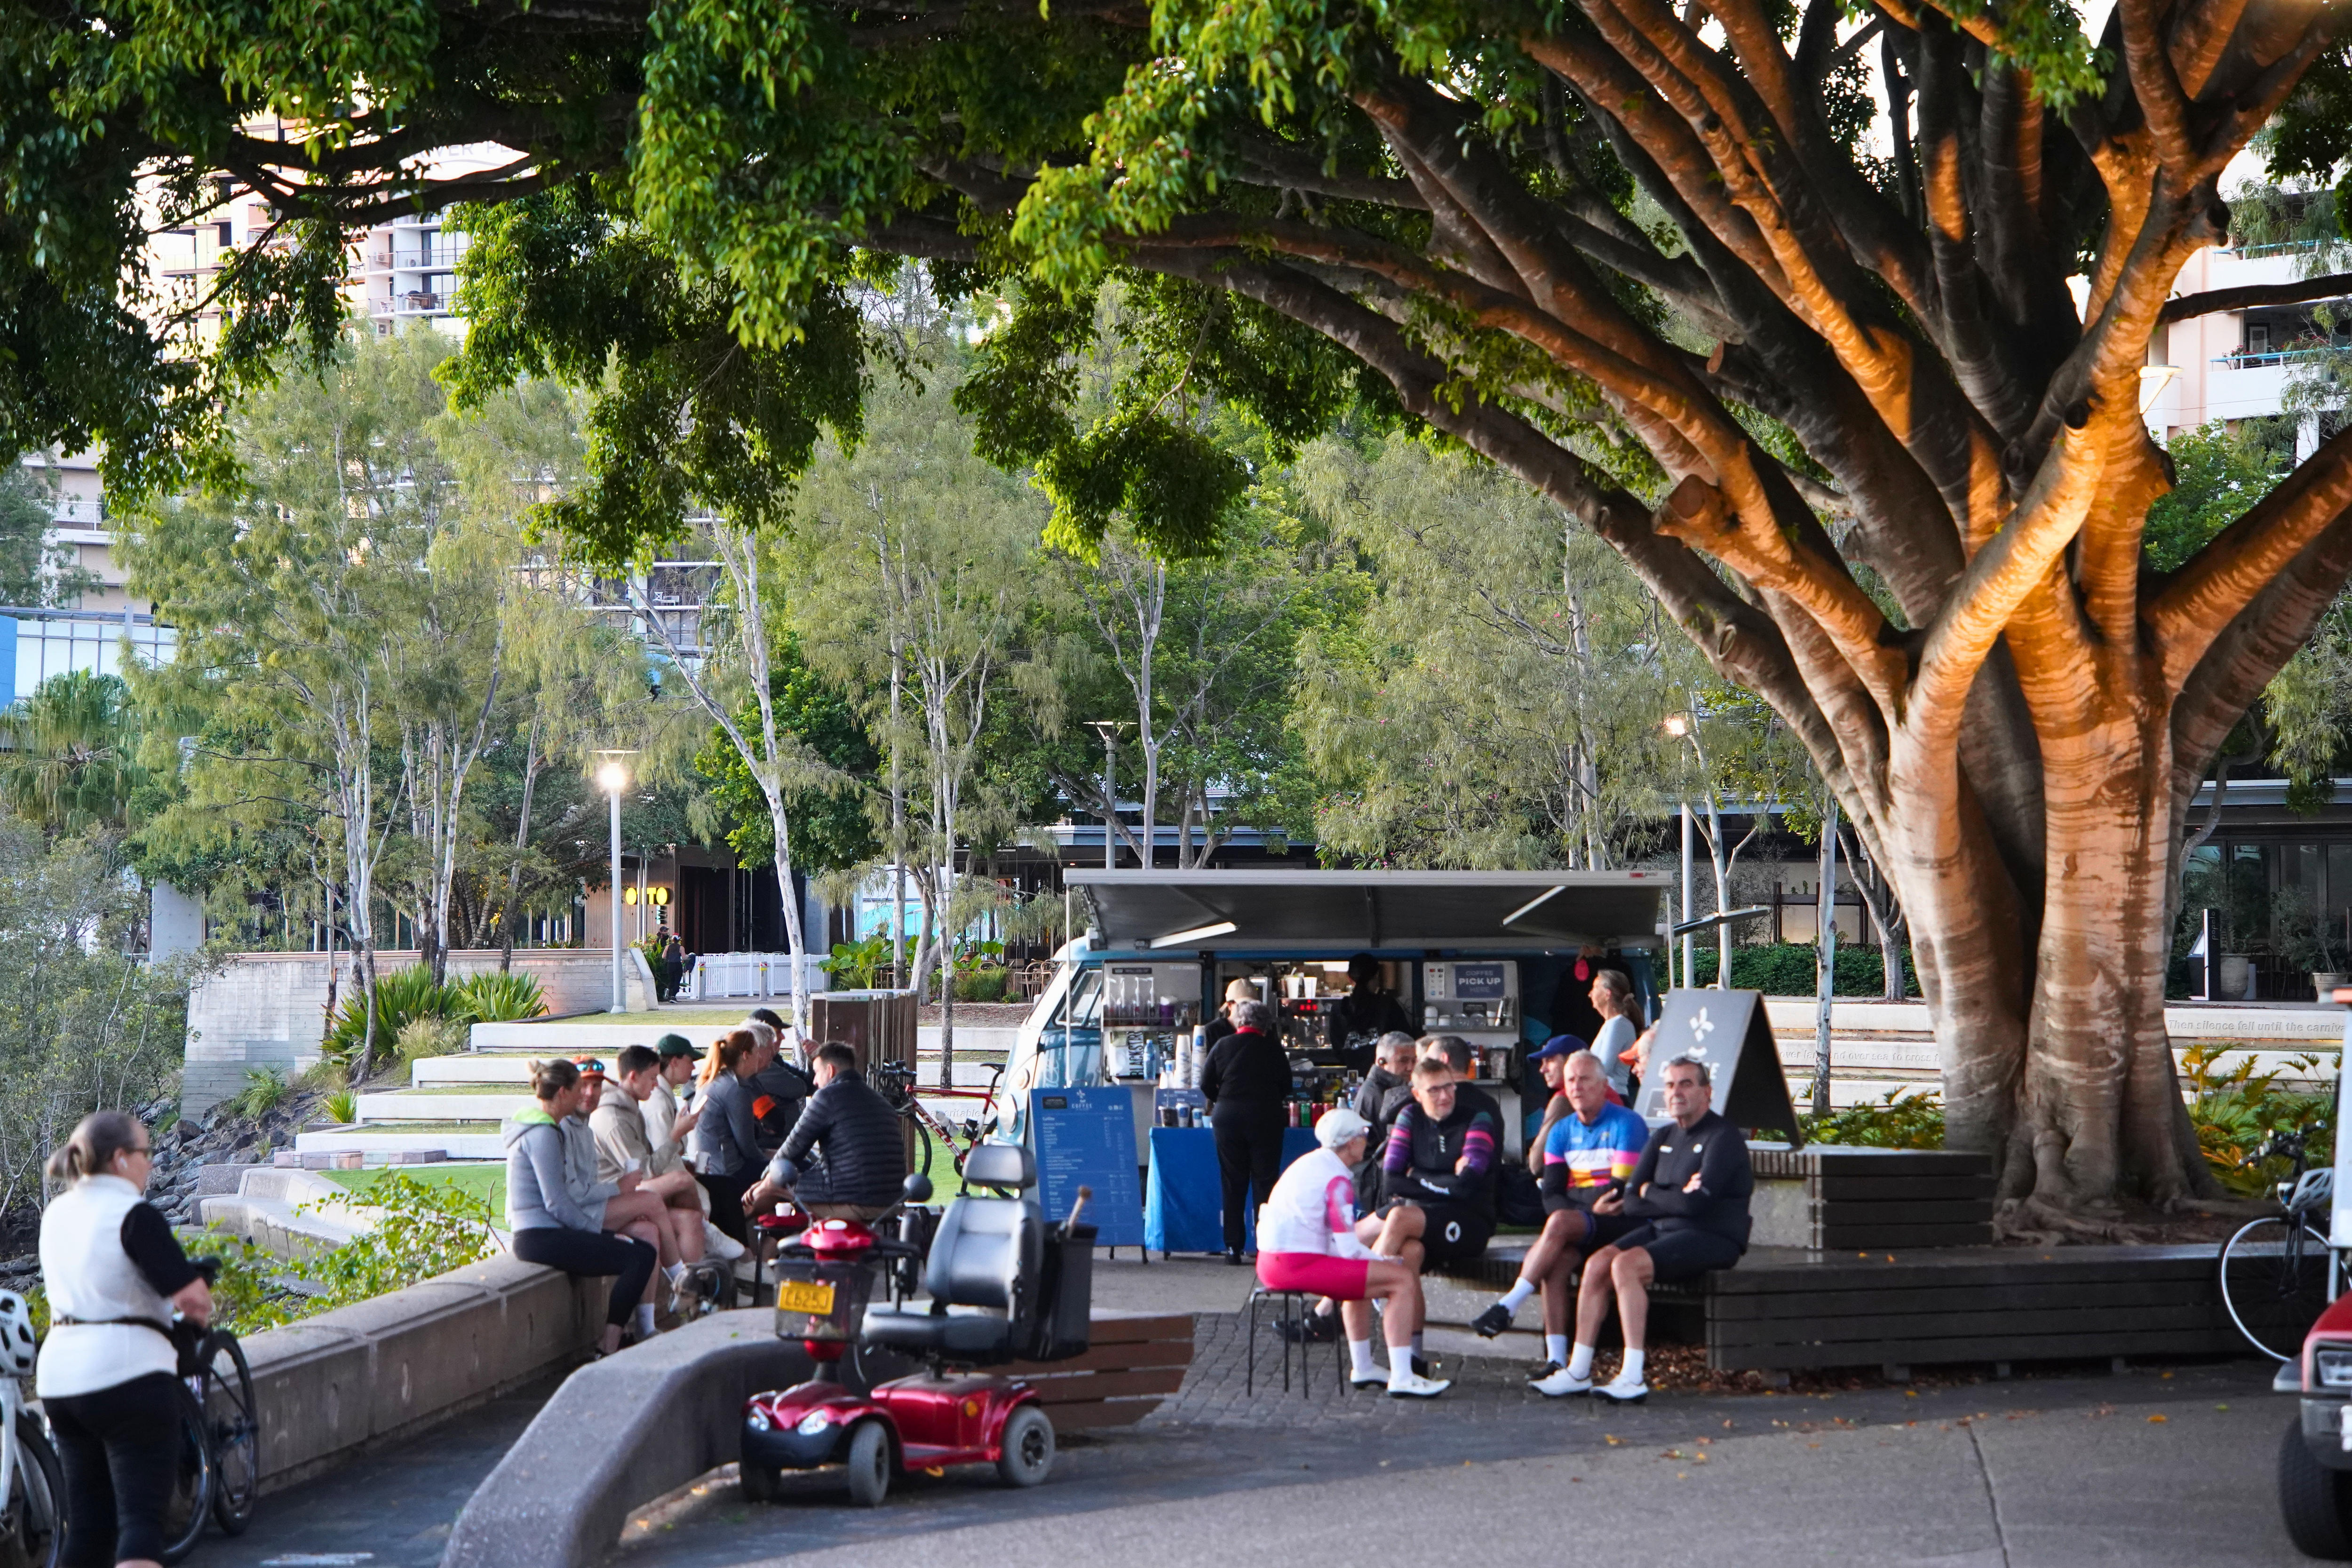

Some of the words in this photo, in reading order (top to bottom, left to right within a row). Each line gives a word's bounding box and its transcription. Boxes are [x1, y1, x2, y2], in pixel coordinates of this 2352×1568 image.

[2209, 912, 2219, 940] popolo
[2169, 1020, 2193, 1029] Then
[2196, 1020, 2234, 1030] silence
[2237, 1021, 2255, 1031] fell
[2257, 1022, 2282, 1031] until
[2285, 1022, 2304, 1032] the
[2306, 1023, 2345, 1033] carniva
[1128, 1031, 1144, 1075] BLACKSTAR
[1892, 1053, 1902, 1061] to
[944, 1109, 980, 1118] eritable
[915, 1105, 962, 1156] FOCUS
